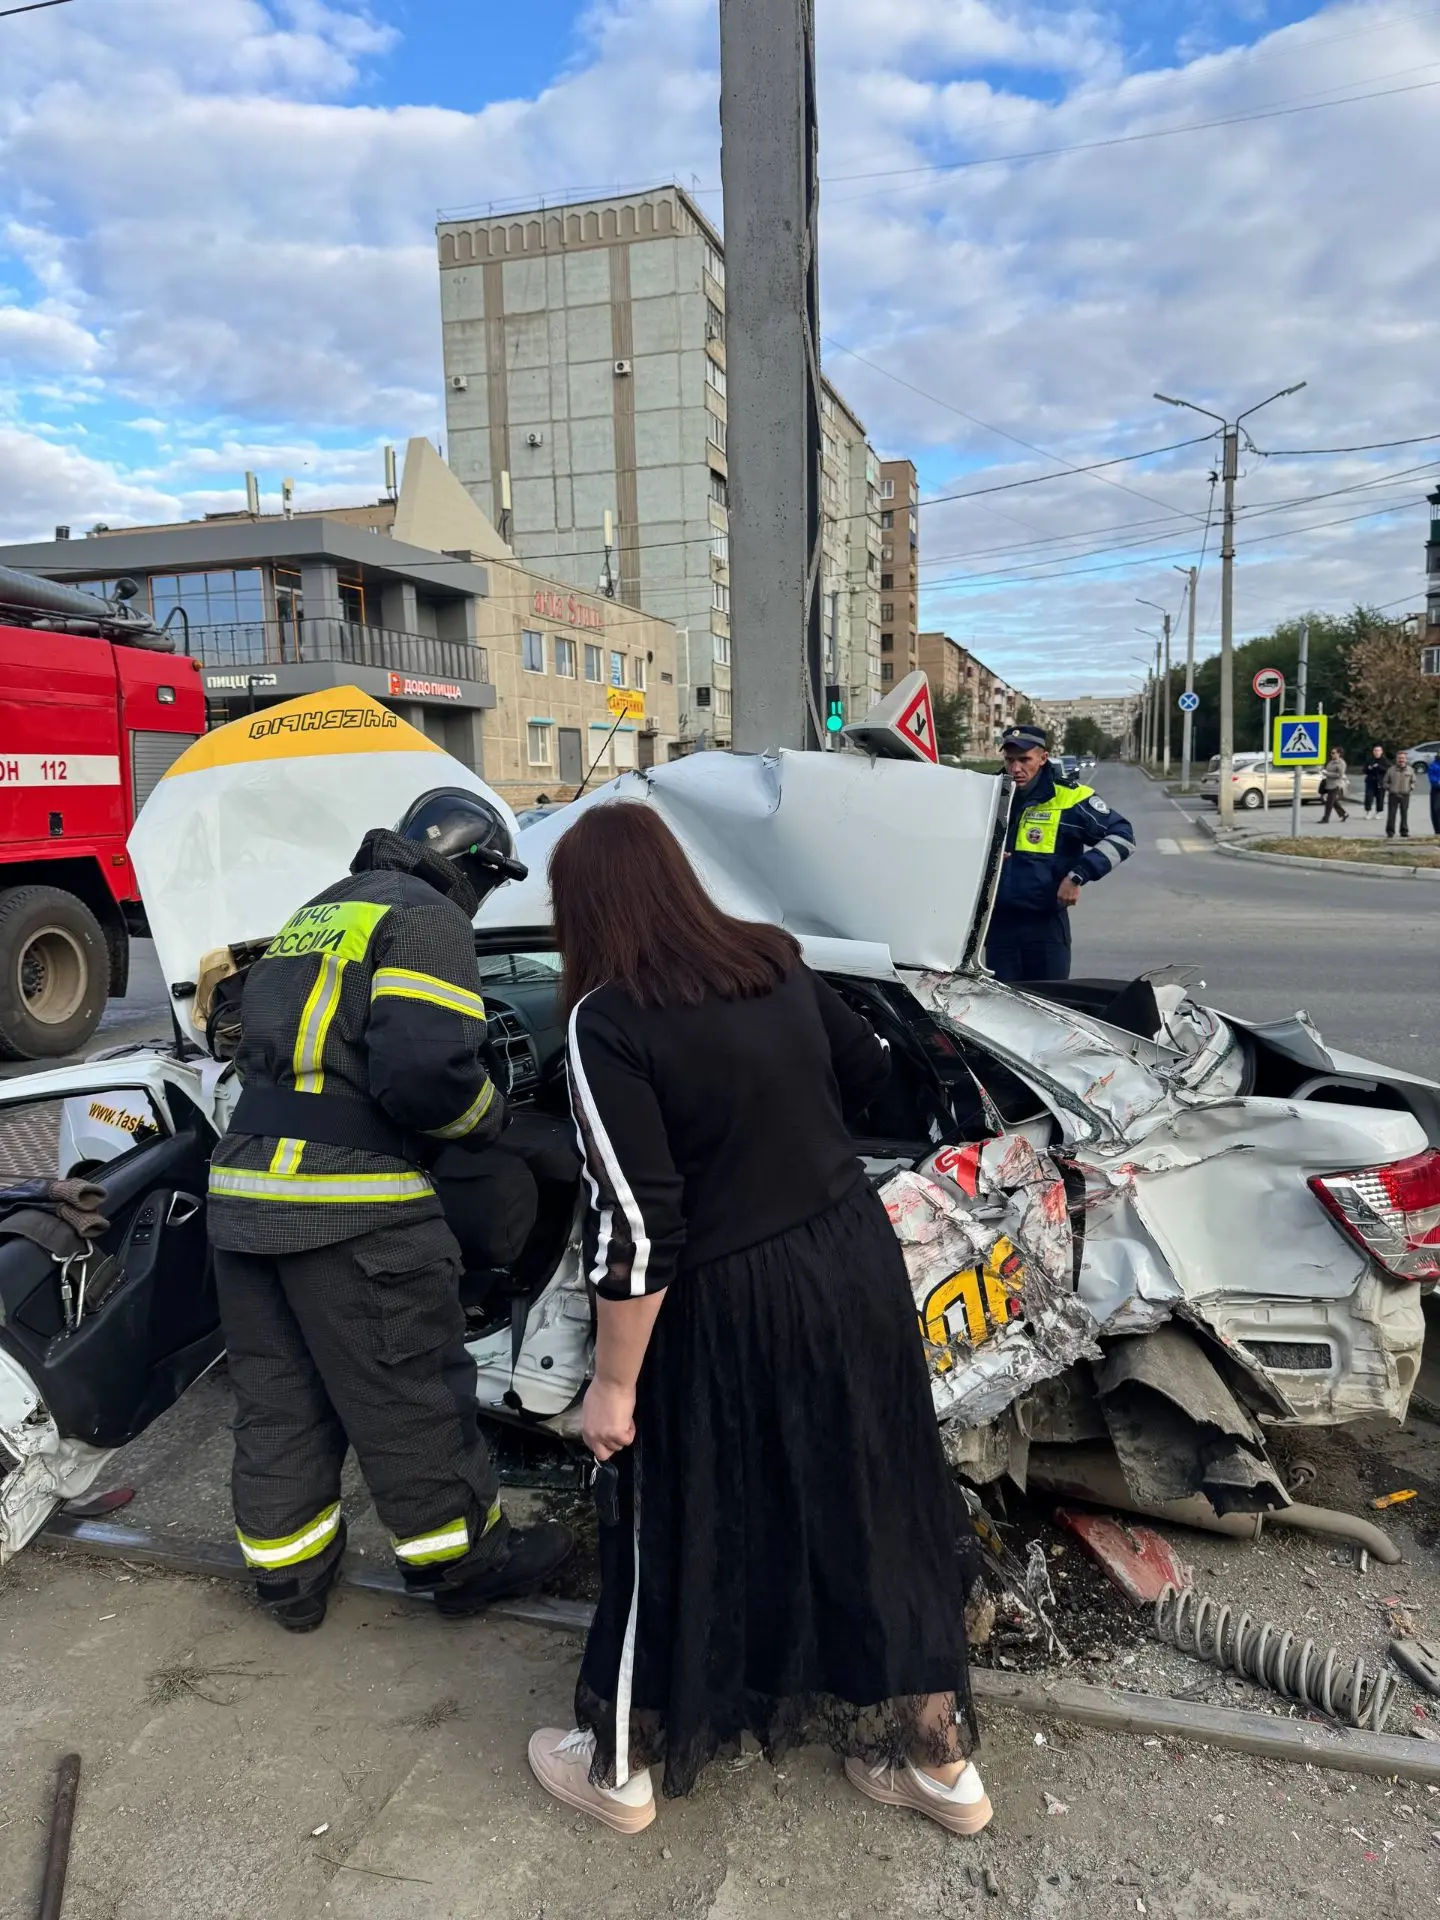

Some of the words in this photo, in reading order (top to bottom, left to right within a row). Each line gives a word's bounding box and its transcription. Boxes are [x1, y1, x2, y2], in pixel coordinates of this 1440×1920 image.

[403, 679, 431, 695] ДОДО
[431, 682, 463, 700] ПИЦЦА
[248, 709, 397, 739] УЧЕБНЫЙ
[40, 760, 68, 780] 112
[288, 904, 341, 929] МЧС
[265, 928, 347, 956] ОССИИ
